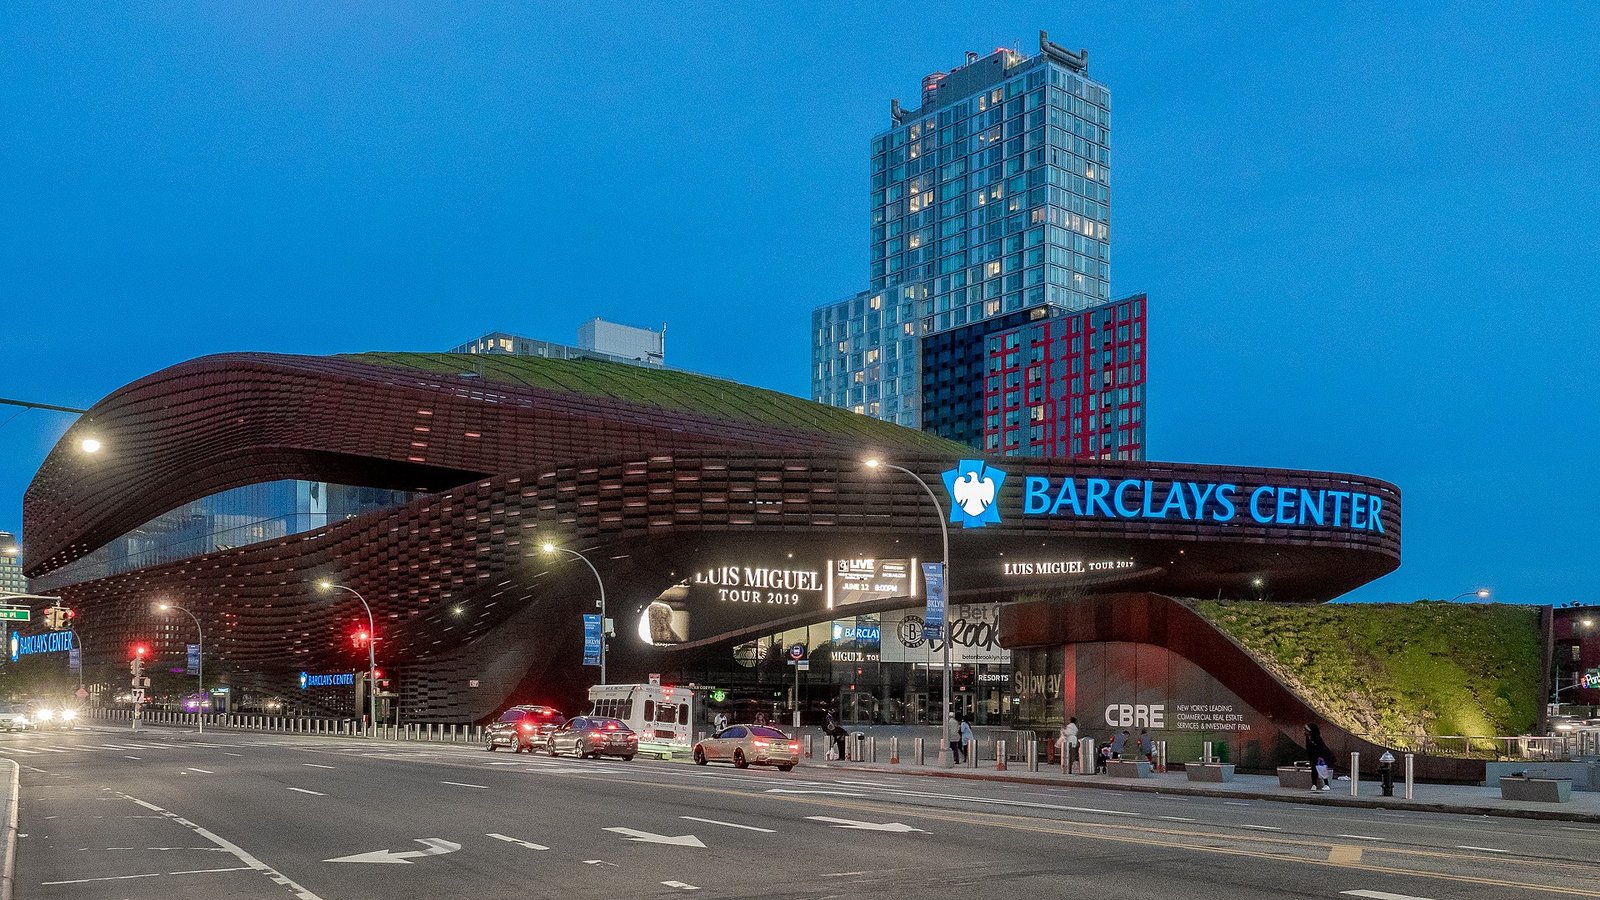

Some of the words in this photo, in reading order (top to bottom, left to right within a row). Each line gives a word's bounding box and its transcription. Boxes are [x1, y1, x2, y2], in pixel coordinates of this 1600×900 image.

[1023, 476, 1236, 521] BARCLAYS
[1250, 485, 1385, 534] CENTER
[850, 559, 875, 569] LIVE
[1004, 563, 1033, 575] LUIS
[1035, 561, 1085, 574] MIGUEL
[1088, 562, 1114, 570] TOUR
[695, 566, 740, 585] LUIS
[744, 567, 823, 591] MIGUEL
[842, 583, 859, 591] JUNE
[874, 584, 898, 592] 8:00PM
[718, 588, 762, 603] TOUR
[767, 592, 799, 605] 2019
[960, 604, 986, 619] Bet
[20, 635, 48, 655] BARCLAYS
[48, 631, 73, 652] CENTER
[308, 675, 332, 686] BARCLAYS
[333, 673, 353, 685] CENTER
[978, 674, 1009, 682] RESORTS
[1015, 670, 1061, 699] Subway
[1104, 704, 1165, 728] CBRE
[1209, 705, 1233, 713] LEADING
[1177, 713, 1211, 721] COMMERCIAL
[1225, 714, 1243, 722] ESTATE
[1177, 722, 1200, 730] SERVICES
[1205, 723, 1237, 731] INVESTMENT
